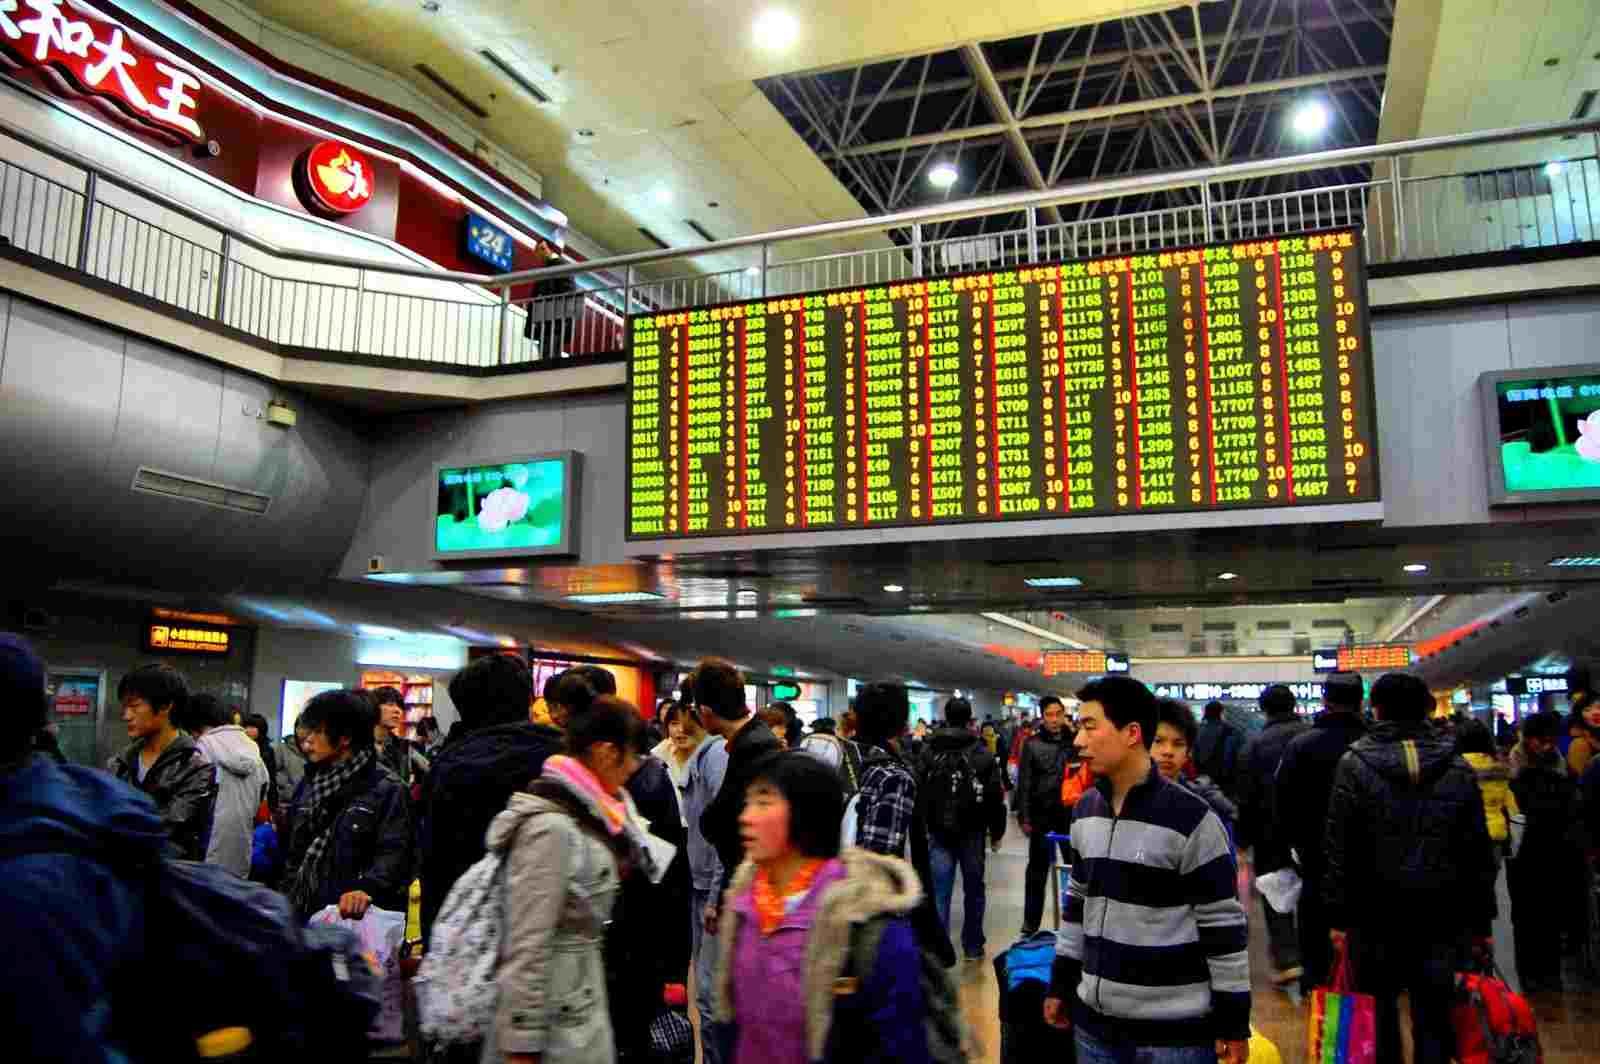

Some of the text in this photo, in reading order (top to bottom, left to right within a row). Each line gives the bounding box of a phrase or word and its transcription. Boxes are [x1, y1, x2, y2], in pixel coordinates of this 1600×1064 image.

[1253, 258, 1265, 272] 6
[1279, 249, 1342, 270] 1135 9
[1060, 275, 1102, 294] K1115
[1130, 268, 1164, 286] L101
[1204, 274, 1266, 295] L723 6
[1280, 266, 1343, 287] 1163 9
[972, 288, 988, 303] 10
[992, 281, 1056, 301] K573 10
[1109, 290, 1119, 304] 7
[1131, 283, 1191, 302] L103 8
[1281, 286, 1317, 304] 1303
[907, 296, 923, 311] 10
[1132, 300, 1191, 319] L155 4
[1205, 291, 1267, 312] L731 4
[907, 312, 923, 326] 10
[1061, 307, 1120, 326] K1179 7
[1206, 308, 1277, 328] L801 10
[1282, 301, 1355, 321] 1427 10
[972, 321, 981, 335] 4
[993, 316, 1026, 333] K597
[1062, 323, 1120, 342] K1363 7
[1133, 319, 1167, 335] L165
[1284, 321, 1319, 338] 1453
[1041, 330, 1058, 344] 10
[1258, 326, 1270, 341] 6
[908, 344, 924, 358] 10
[972, 337, 983, 351] 6
[1063, 340, 1120, 359] K7701 5
[1133, 334, 1193, 352] L187 7
[1259, 343, 1270, 358] 8
[1285, 336, 1357, 355] 1481 10
[973, 353, 983, 367] 7
[1042, 346, 1058, 361] 10
[1134, 352, 1168, 369] L241
[908, 360, 917, 374] 5
[1042, 362, 1059, 377] 10
[1063, 357, 1122, 375] K7725 3
[1208, 361, 1272, 380] L1007 6
[1286, 356, 1322, 373] 1483
[908, 376, 917, 390] 5
[974, 369, 983, 383] 7
[1064, 375, 1106, 392] K7727
[1135, 369, 1170, 386] L245
[1287, 371, 1350, 390] 1487 9
[1042, 379, 1052, 393] 7
[1136, 384, 1197, 403] L253 8
[1210, 378, 1272, 397] L1155 5
[908, 391, 918, 406] 8
[996, 398, 1029, 414] K709
[1064, 389, 1131, 408] L17 10
[1210, 395, 1273, 414] L7707 8
[1287, 389, 1352, 408] 1503 8
[908, 408, 918, 421] 3
[975, 402, 984, 415] 5
[1136, 401, 1197, 419] L277 4
[1341, 407, 1353, 422] 6
[996, 414, 1028, 430] K711
[1065, 410, 1092, 425] L19
[1211, 413, 1274, 431] L7709 2
[909, 423, 926, 437] 10
[997, 430, 1030, 447] K729
[1066, 424, 1125, 442] L29 7
[1290, 424, 1353, 443] 1903 5
[975, 434, 986, 448] 6
[1138, 436, 1199, 454] L299 6
[1212, 431, 1257, 449] L7737
[997, 445, 1054, 463] K731 8
[1067, 443, 1092, 458] L43
[1213, 448, 1276, 466] L7747 5
[1344, 442, 1364, 457] 10
[910, 455, 919, 469] 7
[1139, 453, 1200, 471] L397 7
[1344, 460, 1356, 475] 9
[910, 471, 920, 485] 6
[976, 466, 986, 481] 6
[997, 464, 1031, 479] K749
[1139, 470, 1200, 488] L417 4
[1214, 465, 1286, 483] L7749 10
[976, 483, 987, 497] 6
[1046, 479, 1063, 493] 10
[1067, 474, 1127, 492] L91 8
[1292, 479, 1357, 497] 4487 7
[910, 488, 920, 501] 5
[1068, 493, 1094, 509] L93
[1190, 488, 1201, 502] 5
[1216, 484, 1251, 501] 1133
[1045, 495, 1056, 510] 9
